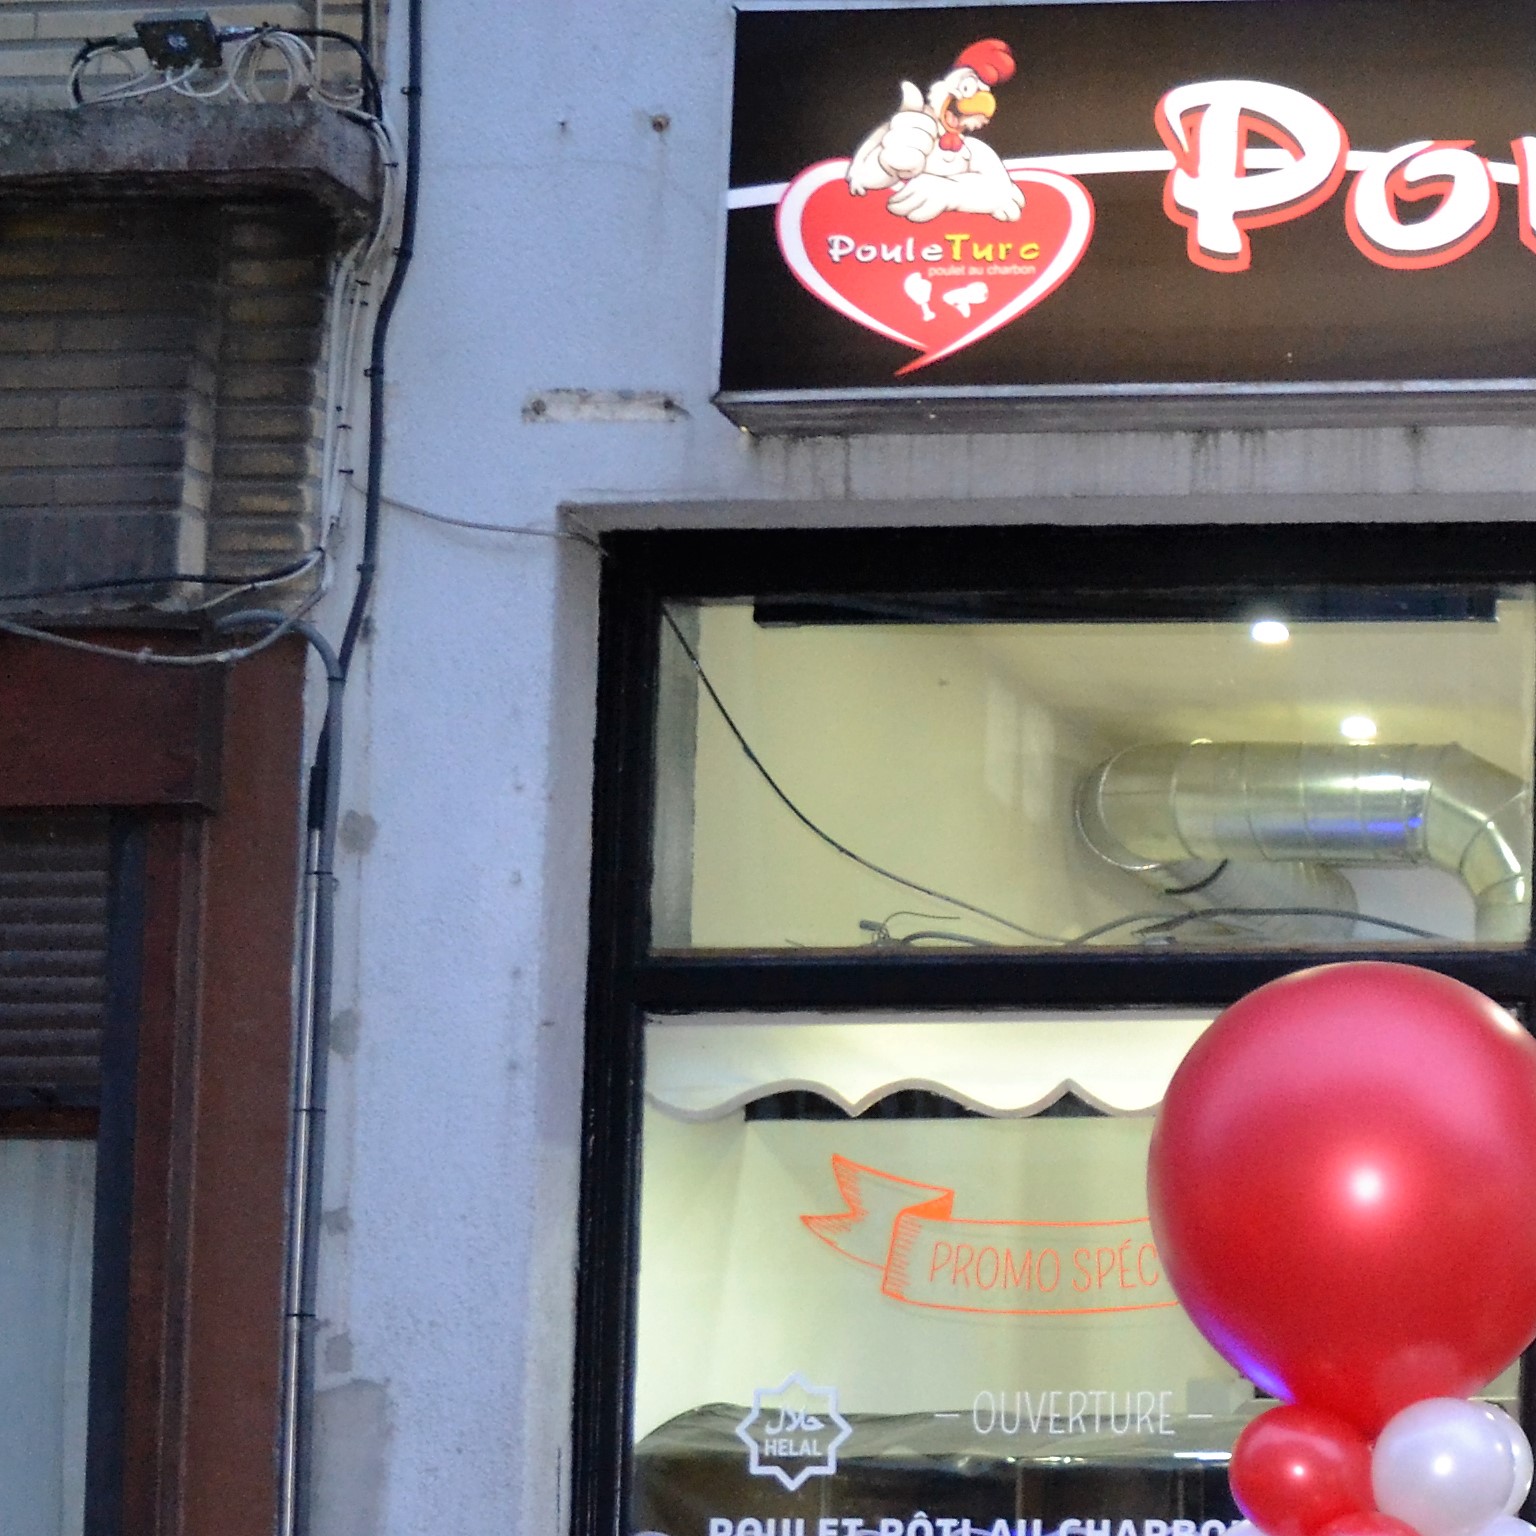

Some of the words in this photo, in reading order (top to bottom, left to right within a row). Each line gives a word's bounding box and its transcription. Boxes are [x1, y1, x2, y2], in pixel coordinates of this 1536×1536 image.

[928, 266, 964, 278] poulet
[968, 265, 984, 276] au
[986, 263, 1036, 275] charbon
[928, 1240, 1061, 1292] PROMO
[1072, 1238, 1160, 1292] SPÉC
[972, 1390, 1176, 1435] OUVERTURE
[764, 1439, 823, 1456] HELAL
